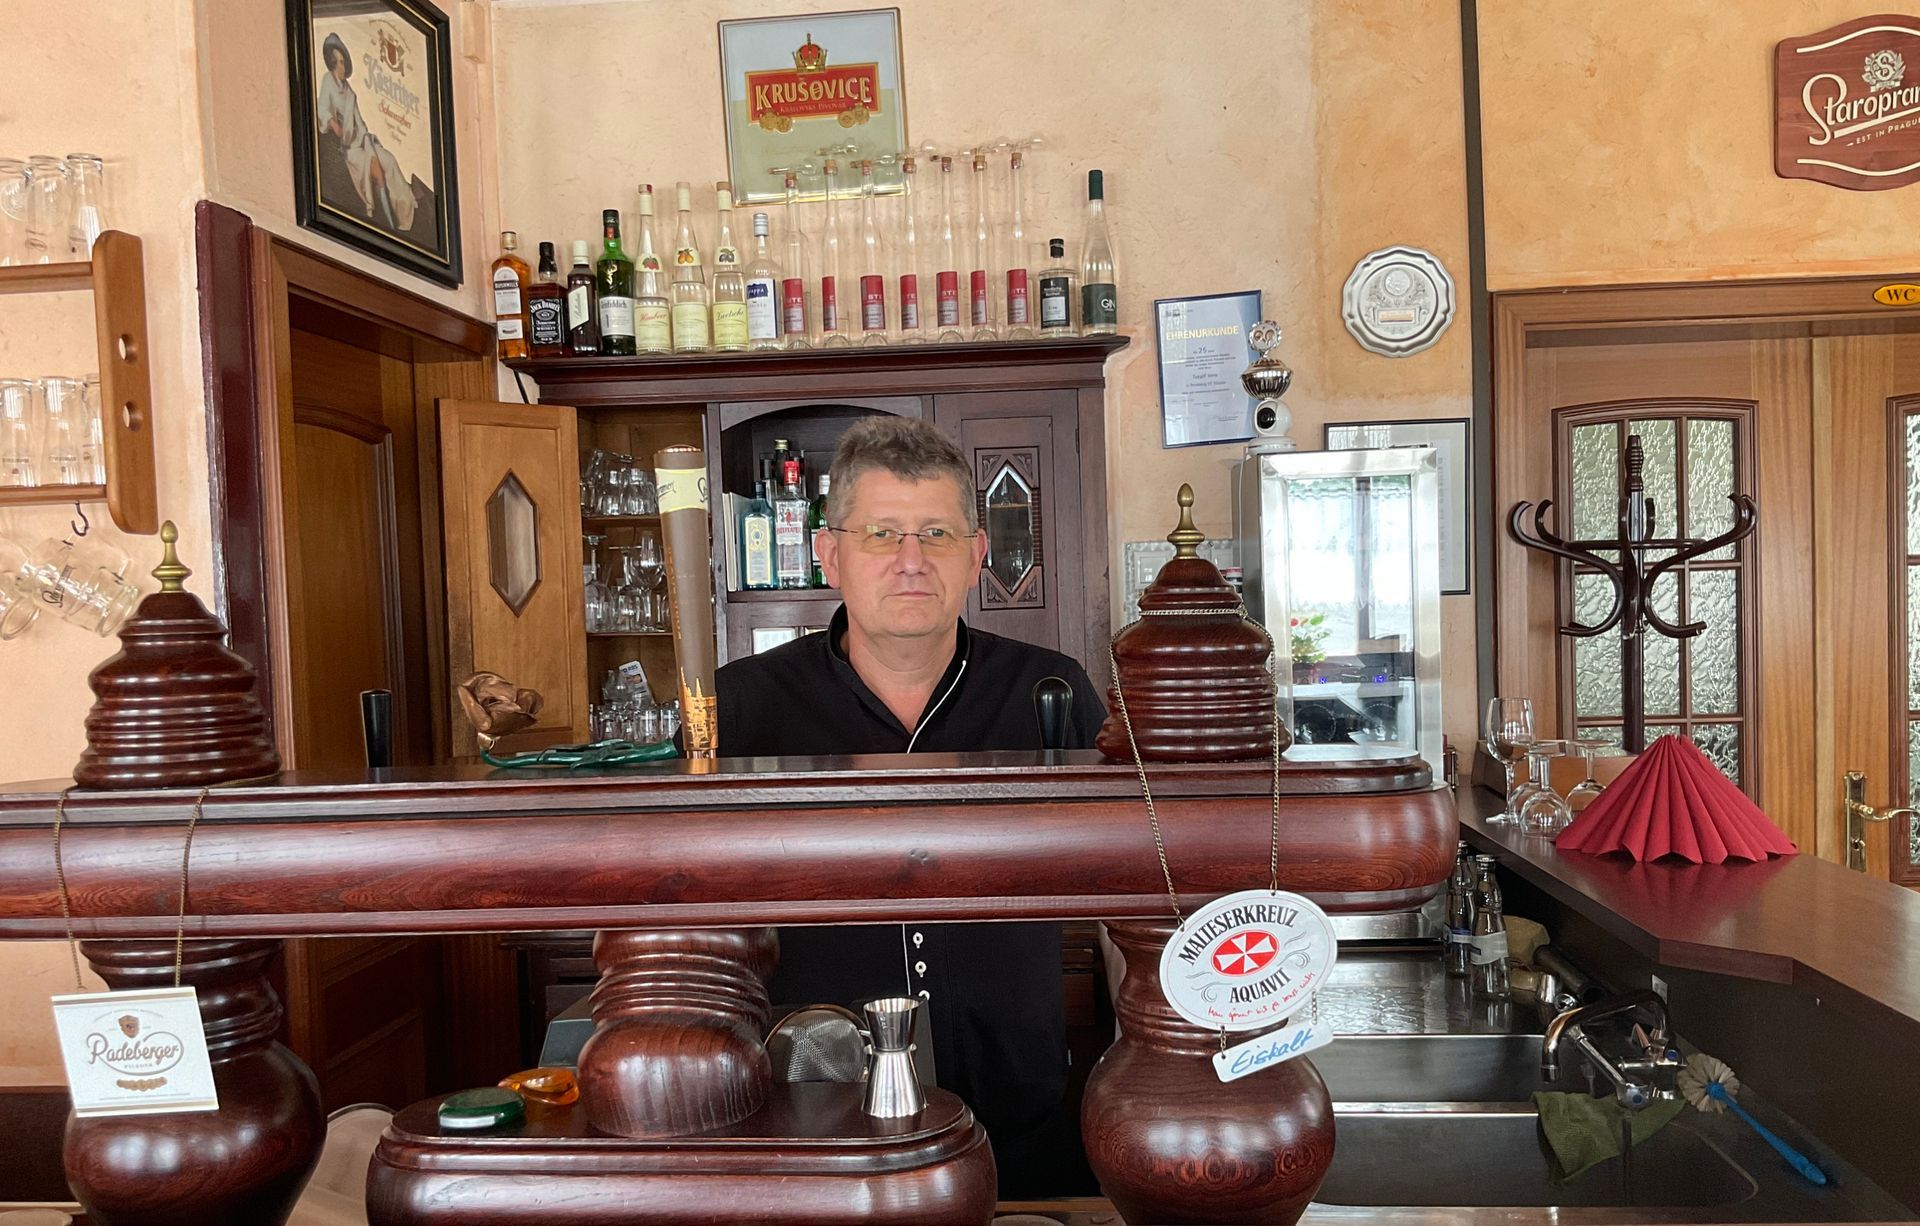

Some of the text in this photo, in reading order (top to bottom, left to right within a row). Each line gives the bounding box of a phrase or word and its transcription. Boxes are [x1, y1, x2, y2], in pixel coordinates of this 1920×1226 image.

[755, 76, 873, 111] KRUŠOVICE
[1856, 134, 1872, 145] EST
[1875, 130, 1885, 138] IN
[530, 303, 542, 313] JACK
[1886, 288, 1916, 302] WC
[1165, 325, 1239, 341] EHRENURKUNDE
[1178, 904, 1300, 966] MALTESERKREUZ
[1229, 967, 1292, 1004] AQUAVIT
[86, 1032, 180, 1066] Radeberger
[1230, 1028, 1315, 1075] Eiskalt
